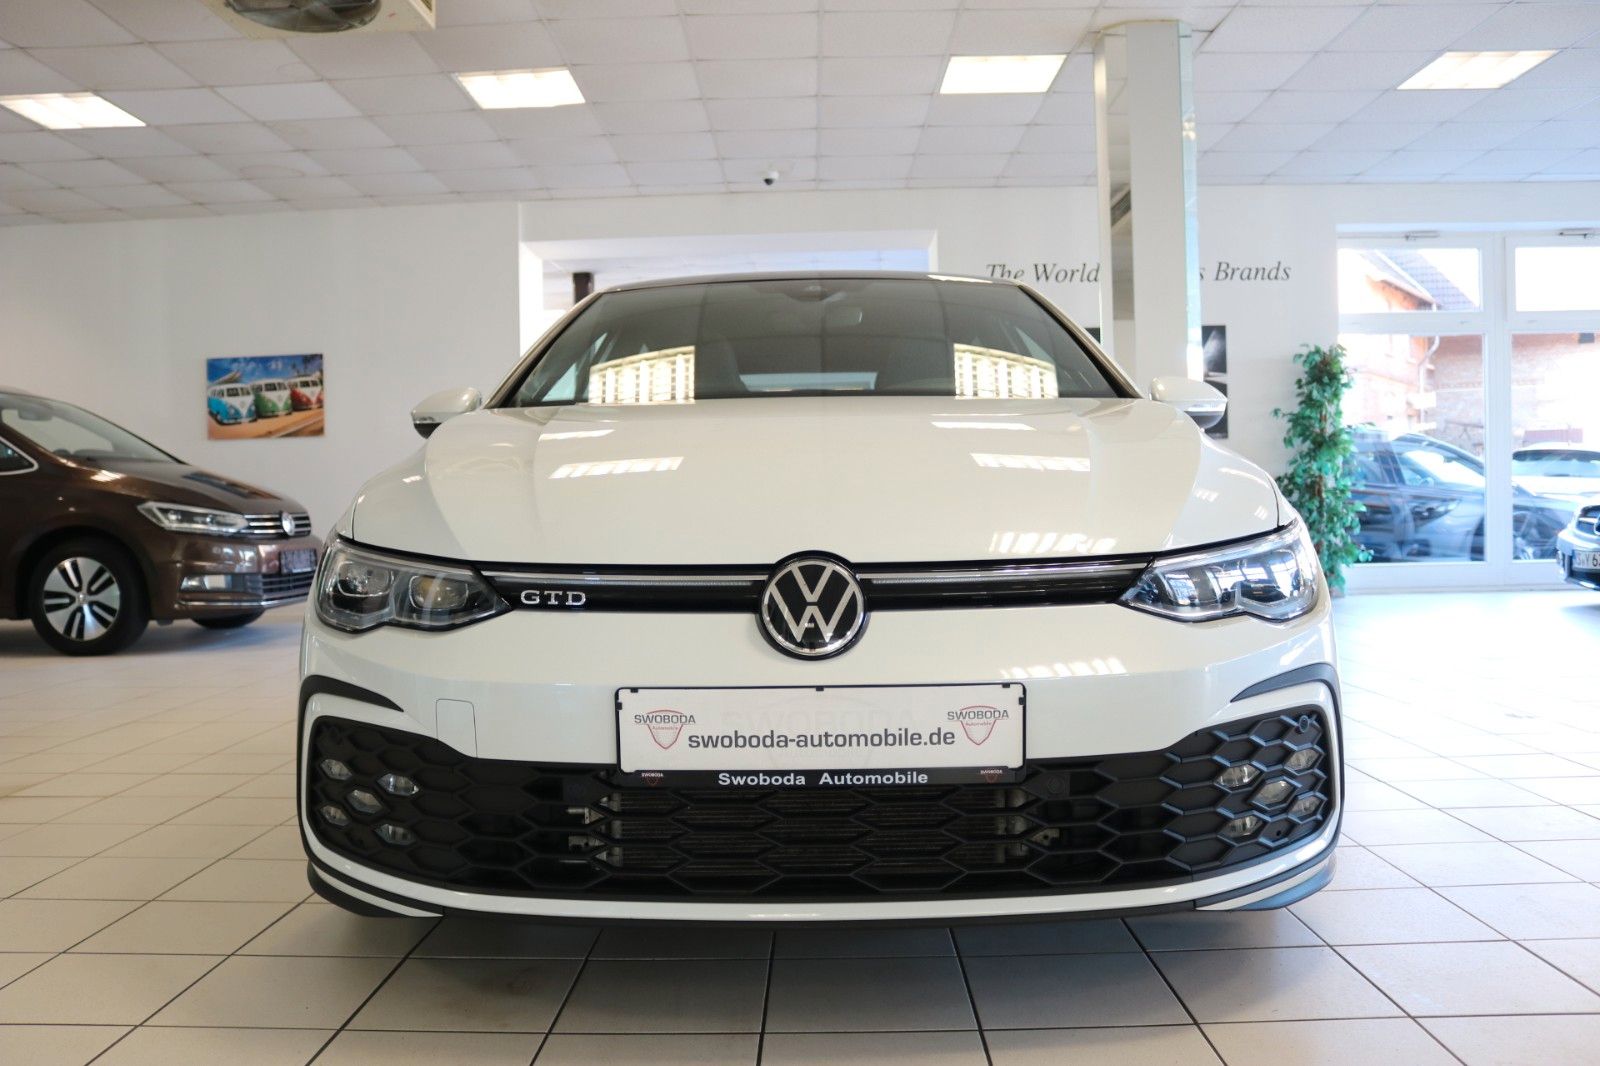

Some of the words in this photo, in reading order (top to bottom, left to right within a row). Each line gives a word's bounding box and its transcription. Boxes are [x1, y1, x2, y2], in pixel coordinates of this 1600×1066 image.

[1033, 262, 1100, 283] World
[1214, 261, 1291, 281] Brands
[520, 589, 586, 606] GTD
[634, 714, 696, 725] SWOBODA
[947, 709, 1009, 721] SWOBODA
[688, 727, 956, 749] swoboda-automobile.de
[718, 772, 806, 785] Swoboda
[819, 771, 928, 785] Automobile
